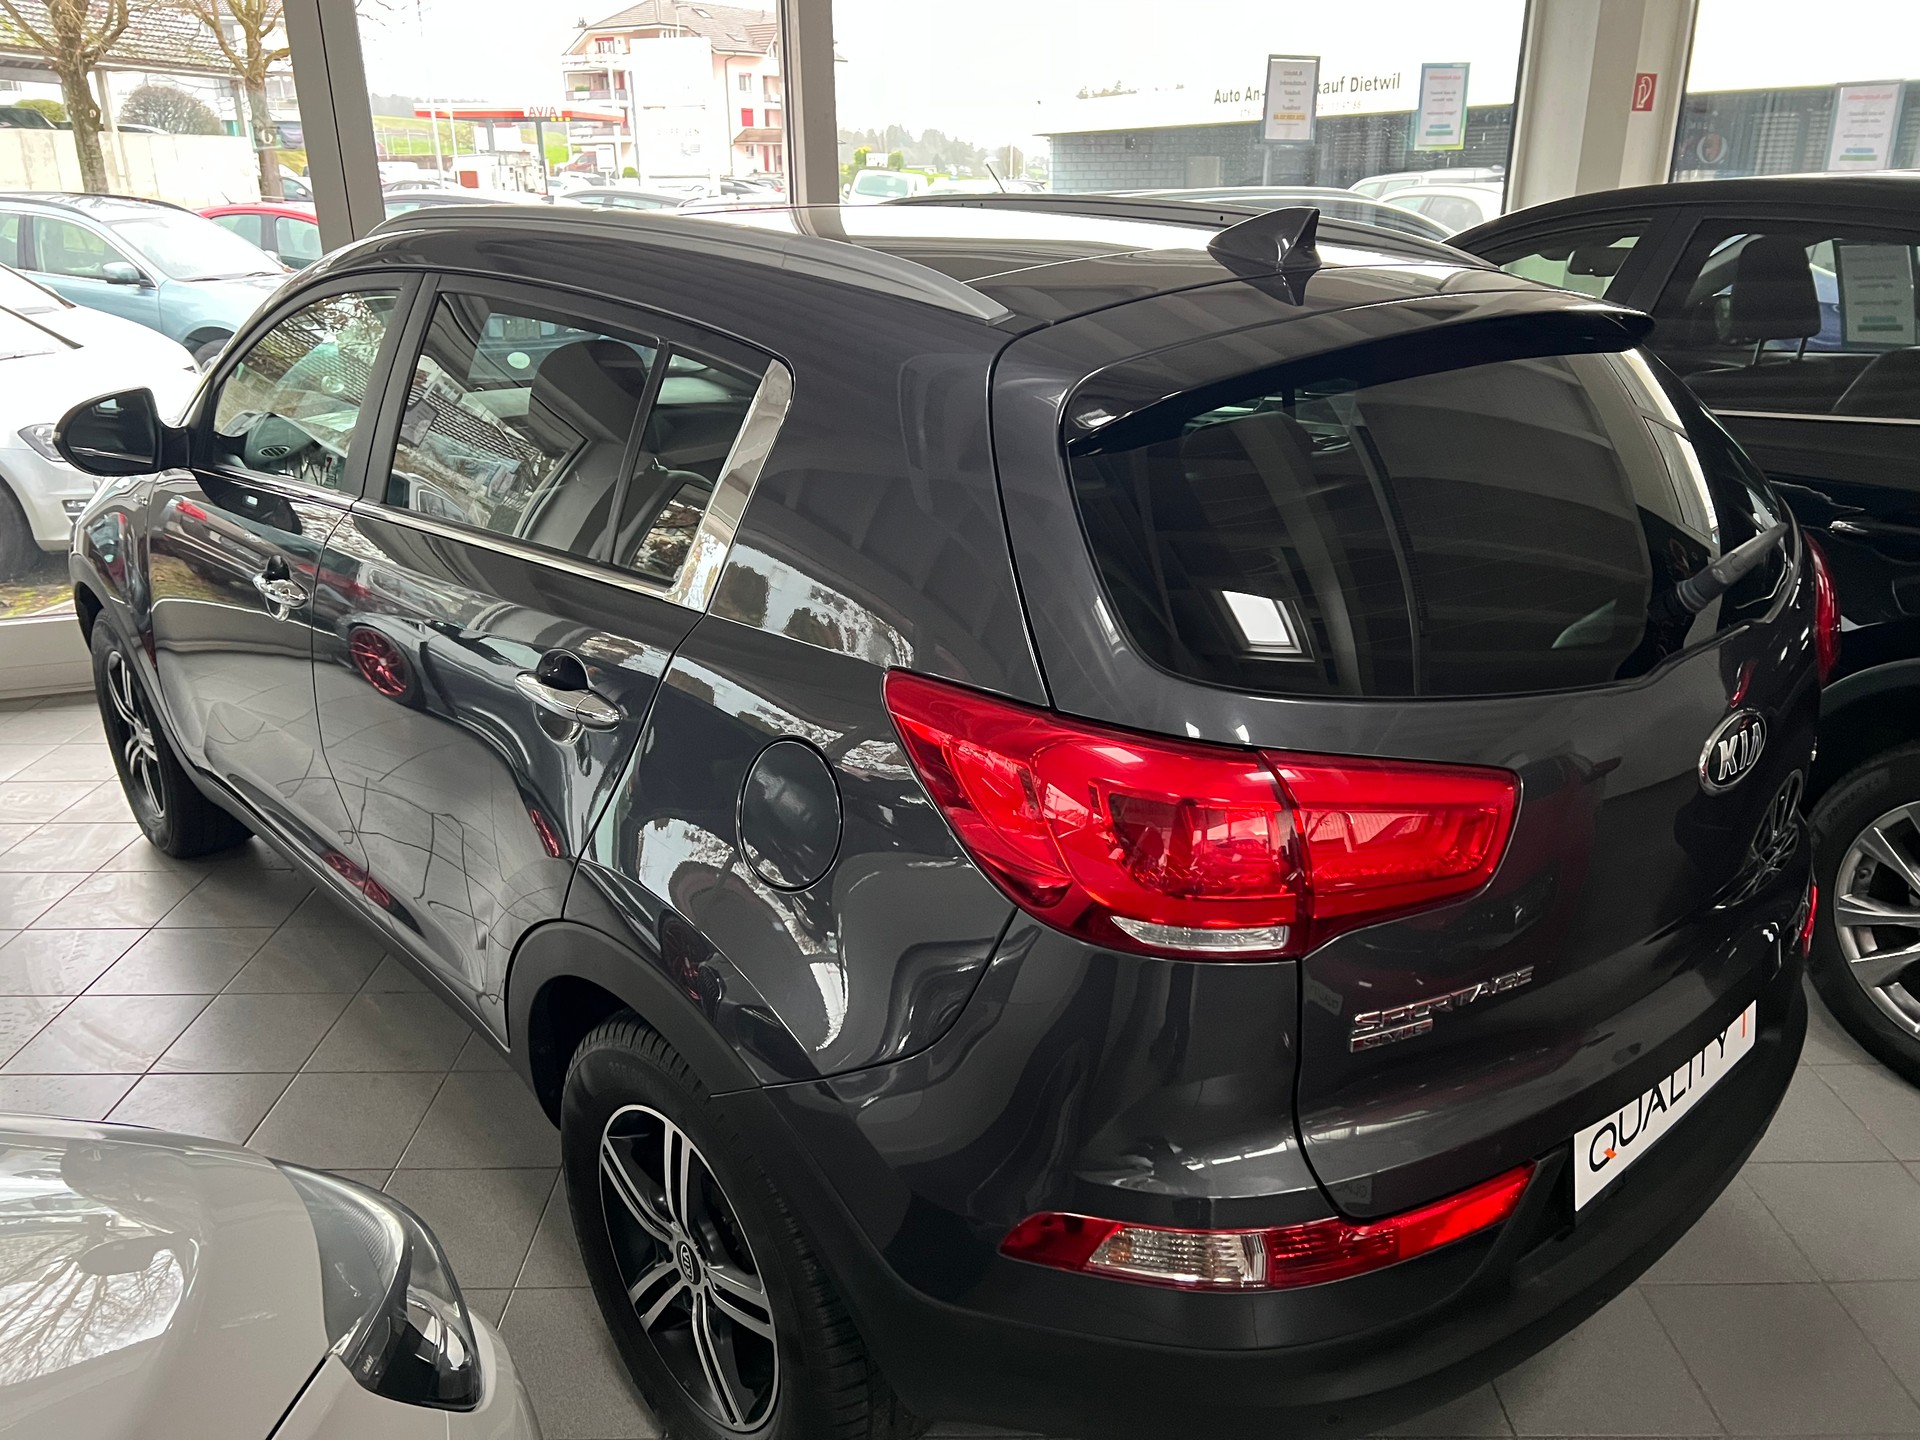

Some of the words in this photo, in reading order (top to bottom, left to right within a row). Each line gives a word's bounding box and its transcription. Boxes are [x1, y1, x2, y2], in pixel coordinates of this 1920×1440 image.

[1213, 88, 1241, 104] Auto
[1350, 72, 1401, 93] Dietwil
[528, 106, 557, 118] AVIA
[1717, 721, 1763, 781] KIA
[1350, 965, 1535, 1035] SPORTAGE
[1359, 1022, 1429, 1049] STYLE
[1588, 1027, 1729, 1173] QUALITY
